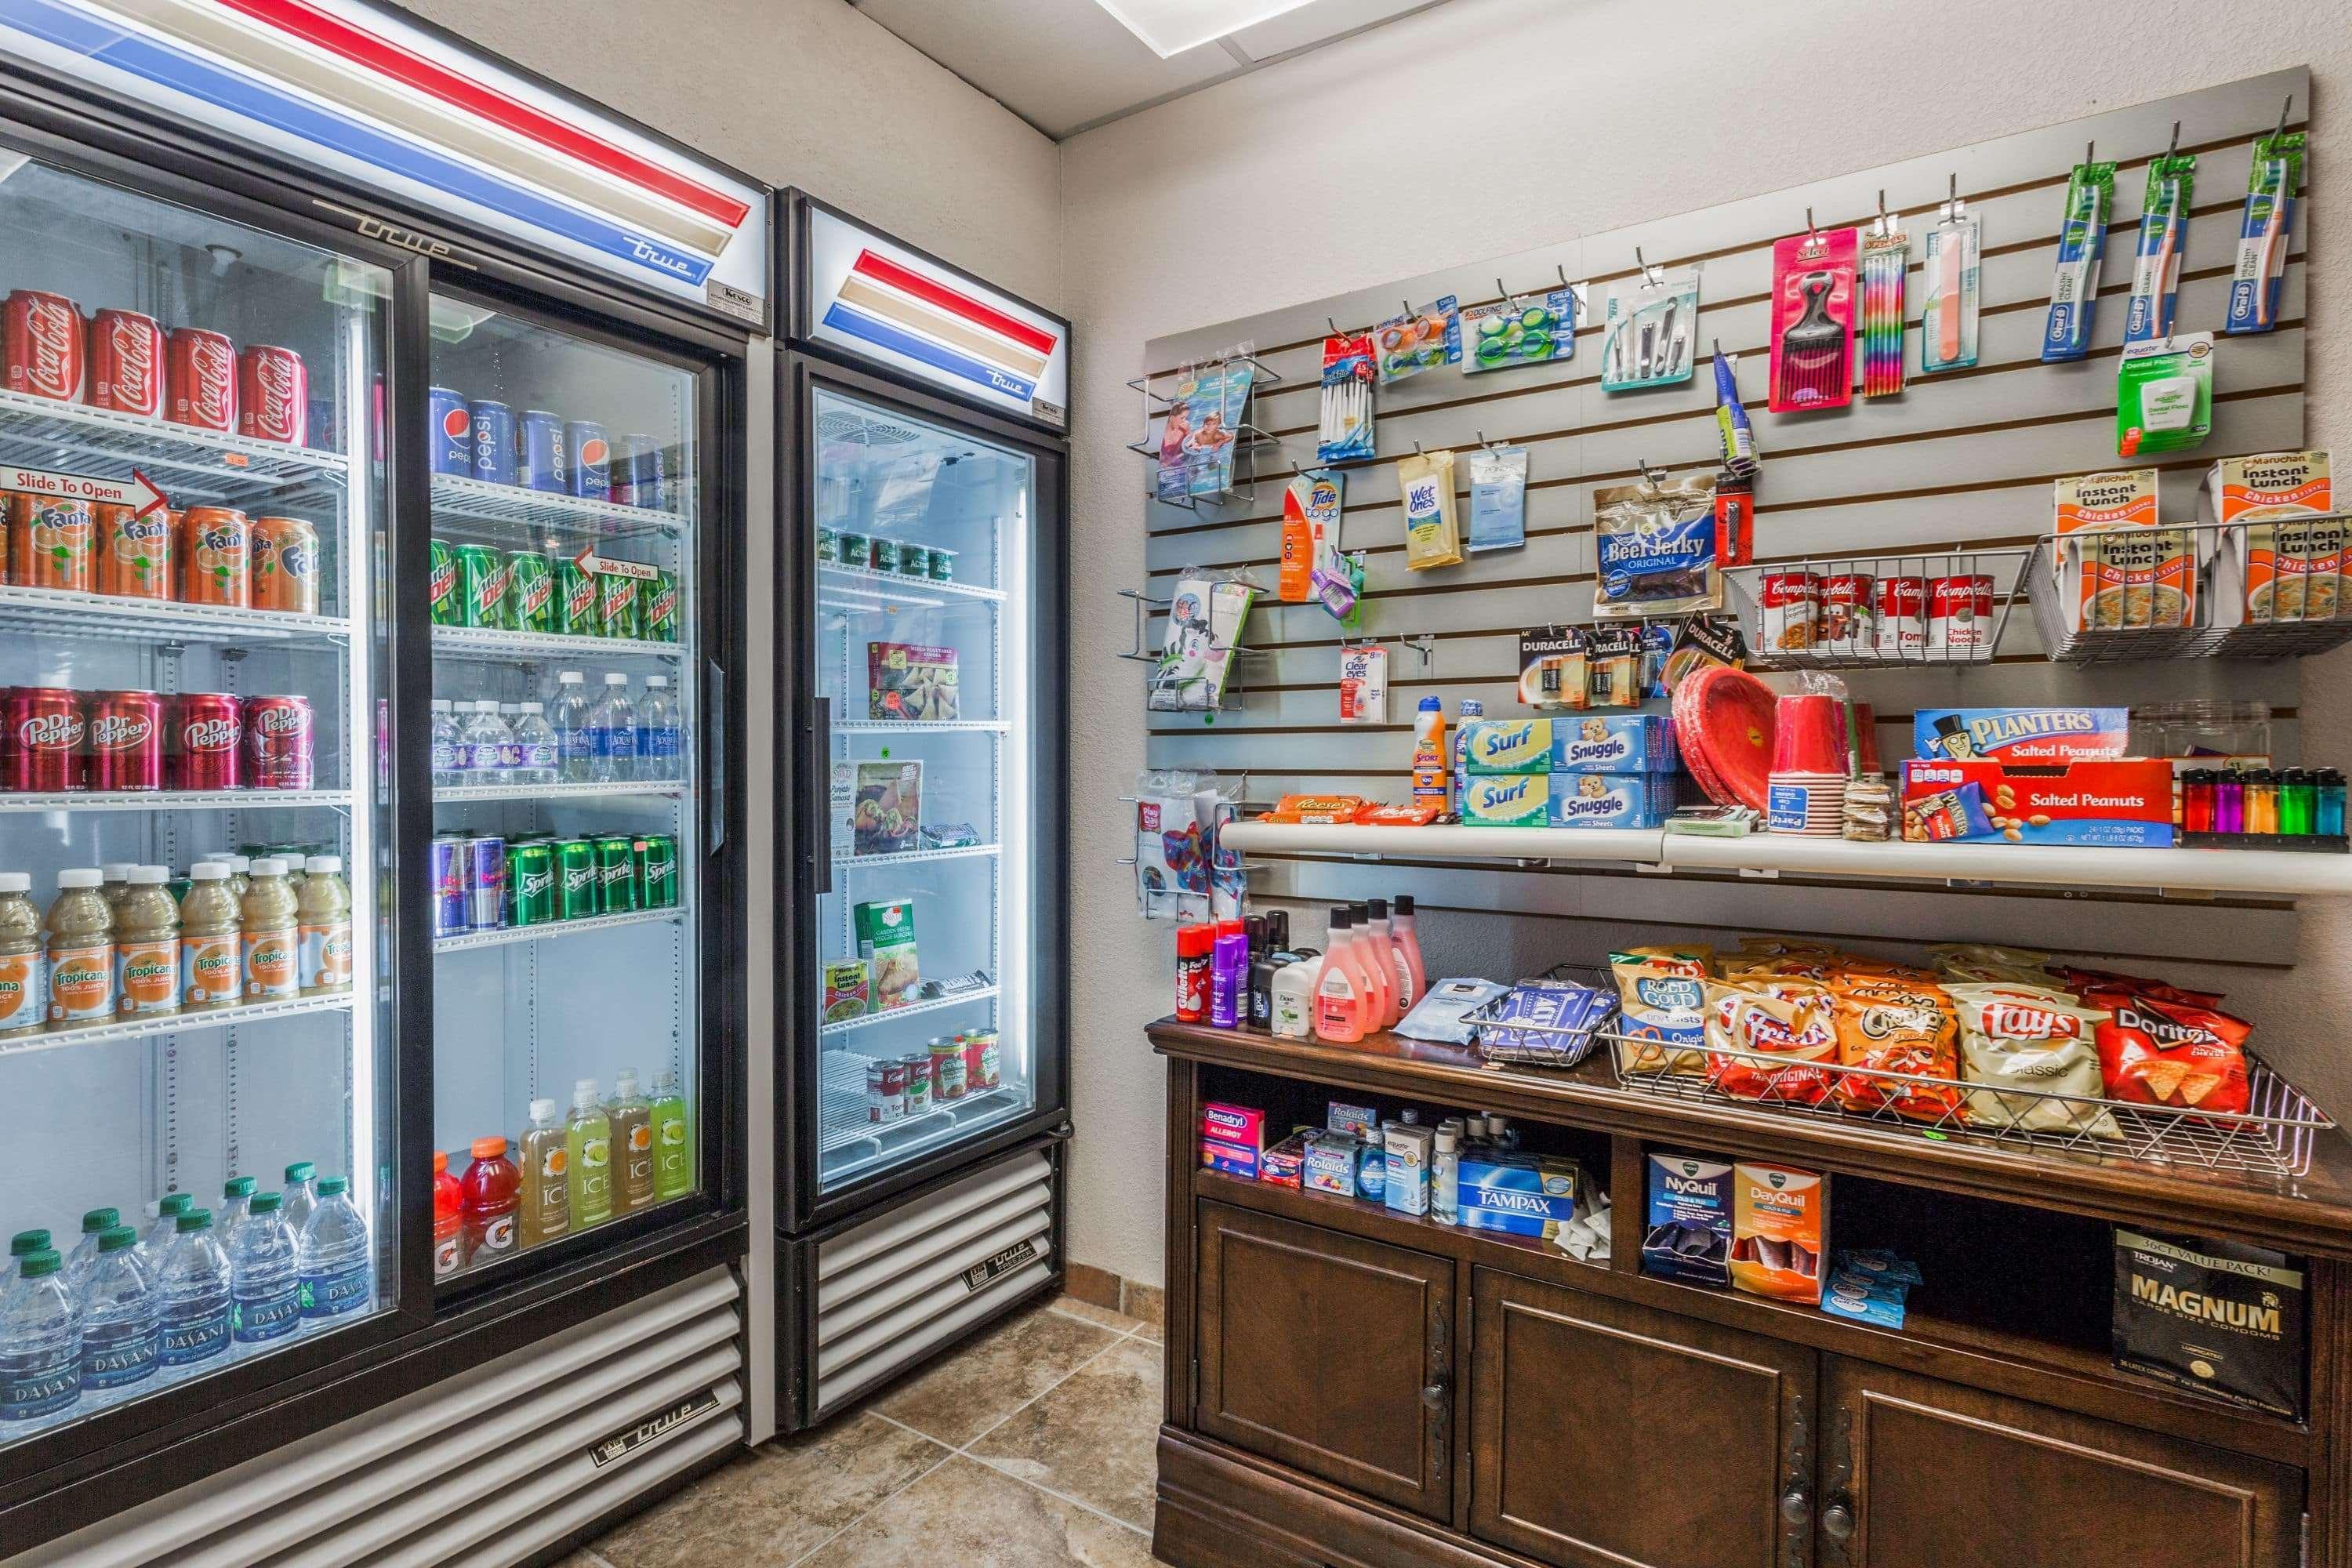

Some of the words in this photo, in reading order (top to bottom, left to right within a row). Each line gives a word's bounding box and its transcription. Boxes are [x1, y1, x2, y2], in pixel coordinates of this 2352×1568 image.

[1797, 247, 1830, 260] Select
[2241, 248, 2252, 277] HEALTHY
[2248, 254, 2258, 277] CLEAN
[2236, 286, 2249, 317] Oral-B
[2054, 308, 2065, 338] Oral-B
[2132, 301, 2143, 331] Oral-B
[2127, 345, 2158, 354] equate
[474, 416, 496, 470] pepsi
[550, 429, 566, 481] pepsi
[2252, 455, 2306, 466] Maruchan
[2242, 465, 2310, 480] Instant
[16, 474, 56, 491] Slide
[61, 479, 78, 493] To
[82, 481, 122, 500] Open
[2250, 475, 2303, 488] Lunch
[1312, 490, 1336, 507] Tide
[1410, 485, 1436, 501] Wet
[2076, 484, 2137, 499] Instant
[2245, 491, 2299, 505] Chicken
[1410, 497, 1435, 513] Ones
[2082, 493, 2131, 507] Lunch
[41, 508, 92, 530] Fanta
[1305, 507, 1319, 517] to
[1322, 508, 1338, 521] go
[2077, 508, 2126, 522] Chicken
[1609, 538, 1648, 563] Beef
[1651, 535, 1704, 557] Jerky
[2103, 540, 2172, 555] Instant
[2281, 540, 2340, 554] Lunch
[1628, 557, 1677, 569] ORIGINAL
[2111, 553, 2165, 566] Lunch
[2277, 557, 2337, 572] Chicken
[600, 561, 619, 572] Slide
[621, 564, 629, 573] To
[631, 566, 651, 577] Open
[1947, 628, 1983, 637] Chicken
[1523, 639, 1581, 652] DURACELL
[1688, 625, 1734, 661] DURACELL
[1345, 662, 1368, 670] Clear
[1346, 670, 1367, 680] eyes
[49, 712, 74, 728] Dr
[106, 714, 131, 730] Dr
[262, 710, 310, 732] Pepper
[278, 707, 304, 721] Dr
[28, 717, 82, 745] Pepper
[93, 720, 149, 746] Pepper
[208, 718, 231, 735] Dr
[1971, 710, 2094, 744] PLANTERS
[1486, 723, 1532, 756] Surf
[1416, 753, 1439, 763] SPORT
[1570, 740, 1624, 760] Snuggle
[2012, 745, 2056, 757] Salted
[2059, 745, 2118, 757] Peanuts
[1483, 781, 1529, 808] Surf
[2030, 793, 2082, 807] Salted
[2084, 793, 2144, 807] Peanuts
[1143, 806, 1160, 818] Play
[1568, 797, 1623, 816] Snuggle
[1944, 792, 1967, 836] PLANTERS
[1143, 816, 1160, 826] Day
[1771, 815, 1802, 826] Party!
[597, 862, 632, 884] Sprite
[125, 964, 176, 979] Tropicana
[198, 956, 241, 971] Tropicana
[56, 971, 107, 986] Tropicana
[834, 973, 860, 983] Instant
[837, 980, 858, 989] Lunch
[1178, 961, 1189, 1009] Gillette
[1646, 979, 1692, 993] ROLD
[1279, 994, 1295, 1003] Dove
[1643, 990, 1701, 1008] GOLD
[2118, 1008, 2219, 1044] Doritos
[1891, 1031, 1935, 1043] Crunchy
[1769, 1067, 1824, 1083] ORIGINAL
[1208, 1110, 1243, 1127] Benadryl
[1334, 1106, 1369, 1121] Rolaids
[1210, 1127, 1242, 1138] ALLERGY
[1388, 1140, 1409, 1149] equate
[630, 1161, 652, 1178] ICE
[1307, 1156, 1349, 1174] Rolaids
[583, 1177, 609, 1195] ICE
[1665, 1175, 1717, 1196] NyQuil
[1479, 1191, 1550, 1214] TAMPAX
[1751, 1187, 1806, 1207] DayQuil
[998, 1250, 1032, 1271] FREEZER
[2133, 1250, 2174, 1269] TROJAN
[2143, 1238, 2172, 1254] 36CT
[2177, 1249, 2222, 1269] VALUE
[2226, 1261, 2271, 1277] PACK!
[2132, 1273, 2280, 1334] MAGNUM
[256, 1301, 299, 1325] DASAN
[2132, 1298, 2170, 1315] LARGE
[2176, 1311, 2205, 1324] SIZE
[2210, 1322, 2281, 1341] CONDOMS
[165, 1324, 225, 1349] DASANI
[96, 1342, 157, 1372] DASANI
[2181, 1344, 2224, 1360] LUBRICATED
[2127, 1361, 2147, 1374] LATEX
[16, 1374, 79, 1403] DASANI
